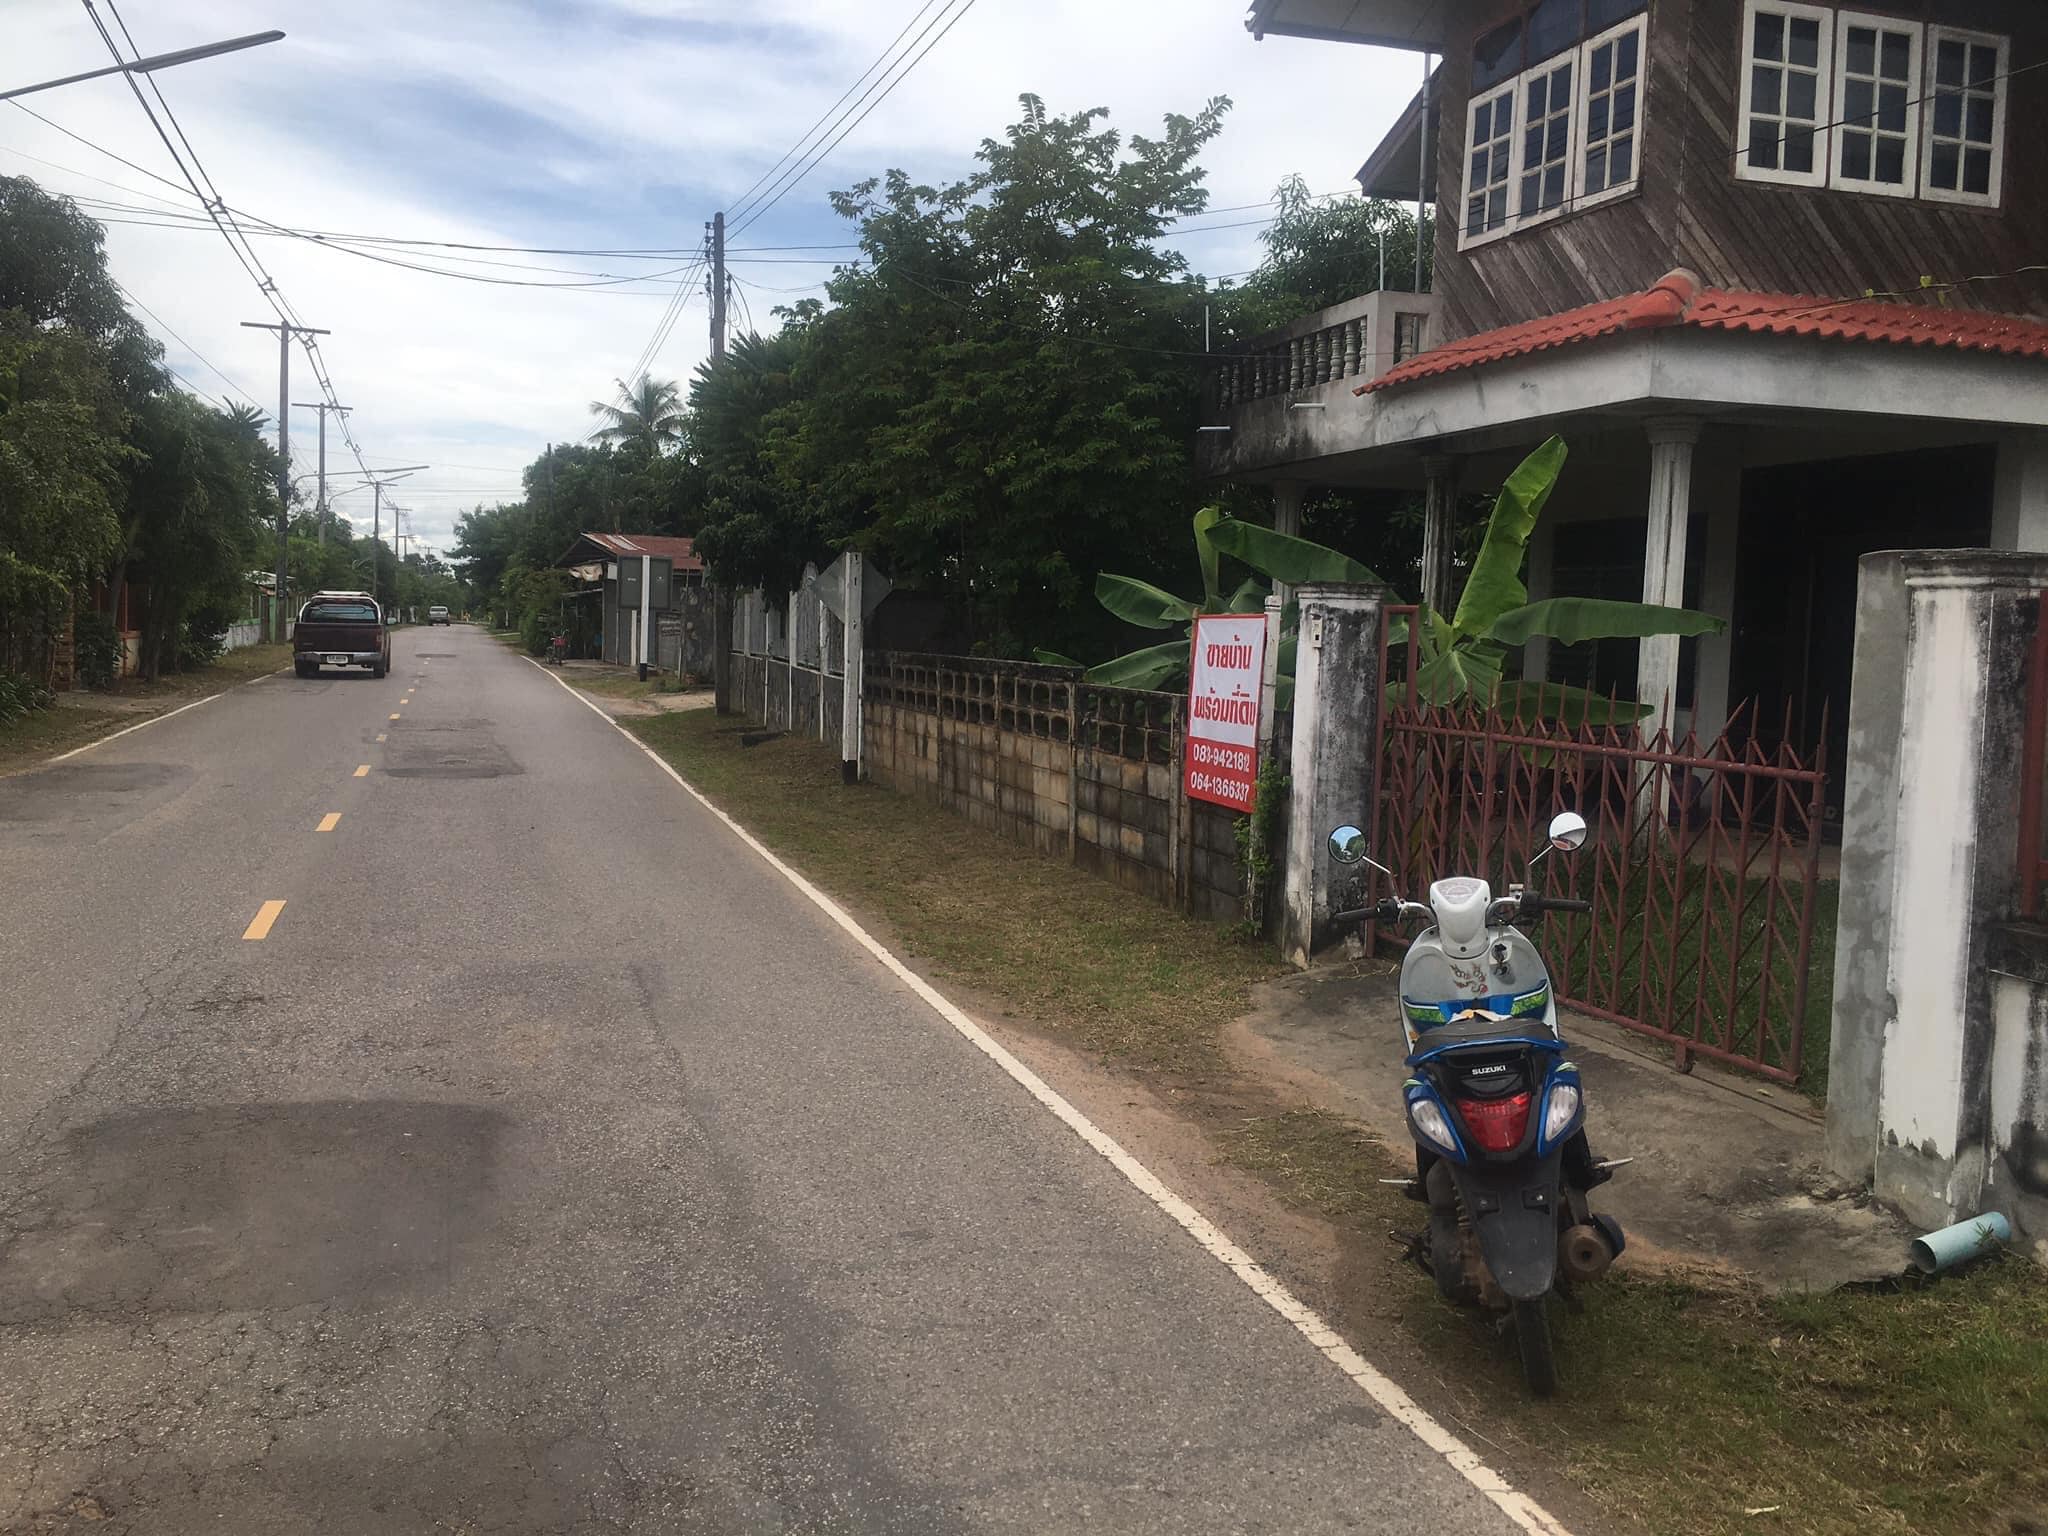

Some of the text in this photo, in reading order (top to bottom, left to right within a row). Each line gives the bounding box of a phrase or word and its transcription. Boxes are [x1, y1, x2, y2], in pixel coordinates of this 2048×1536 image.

[1207, 634, 1252, 670] ขายบ้าน
[1194, 683, 1256, 726] พร้อมที่ดิน
[1190, 771, 1250, 803] 064-1366337
[1471, 1064, 1506, 1076] SUZUKI
